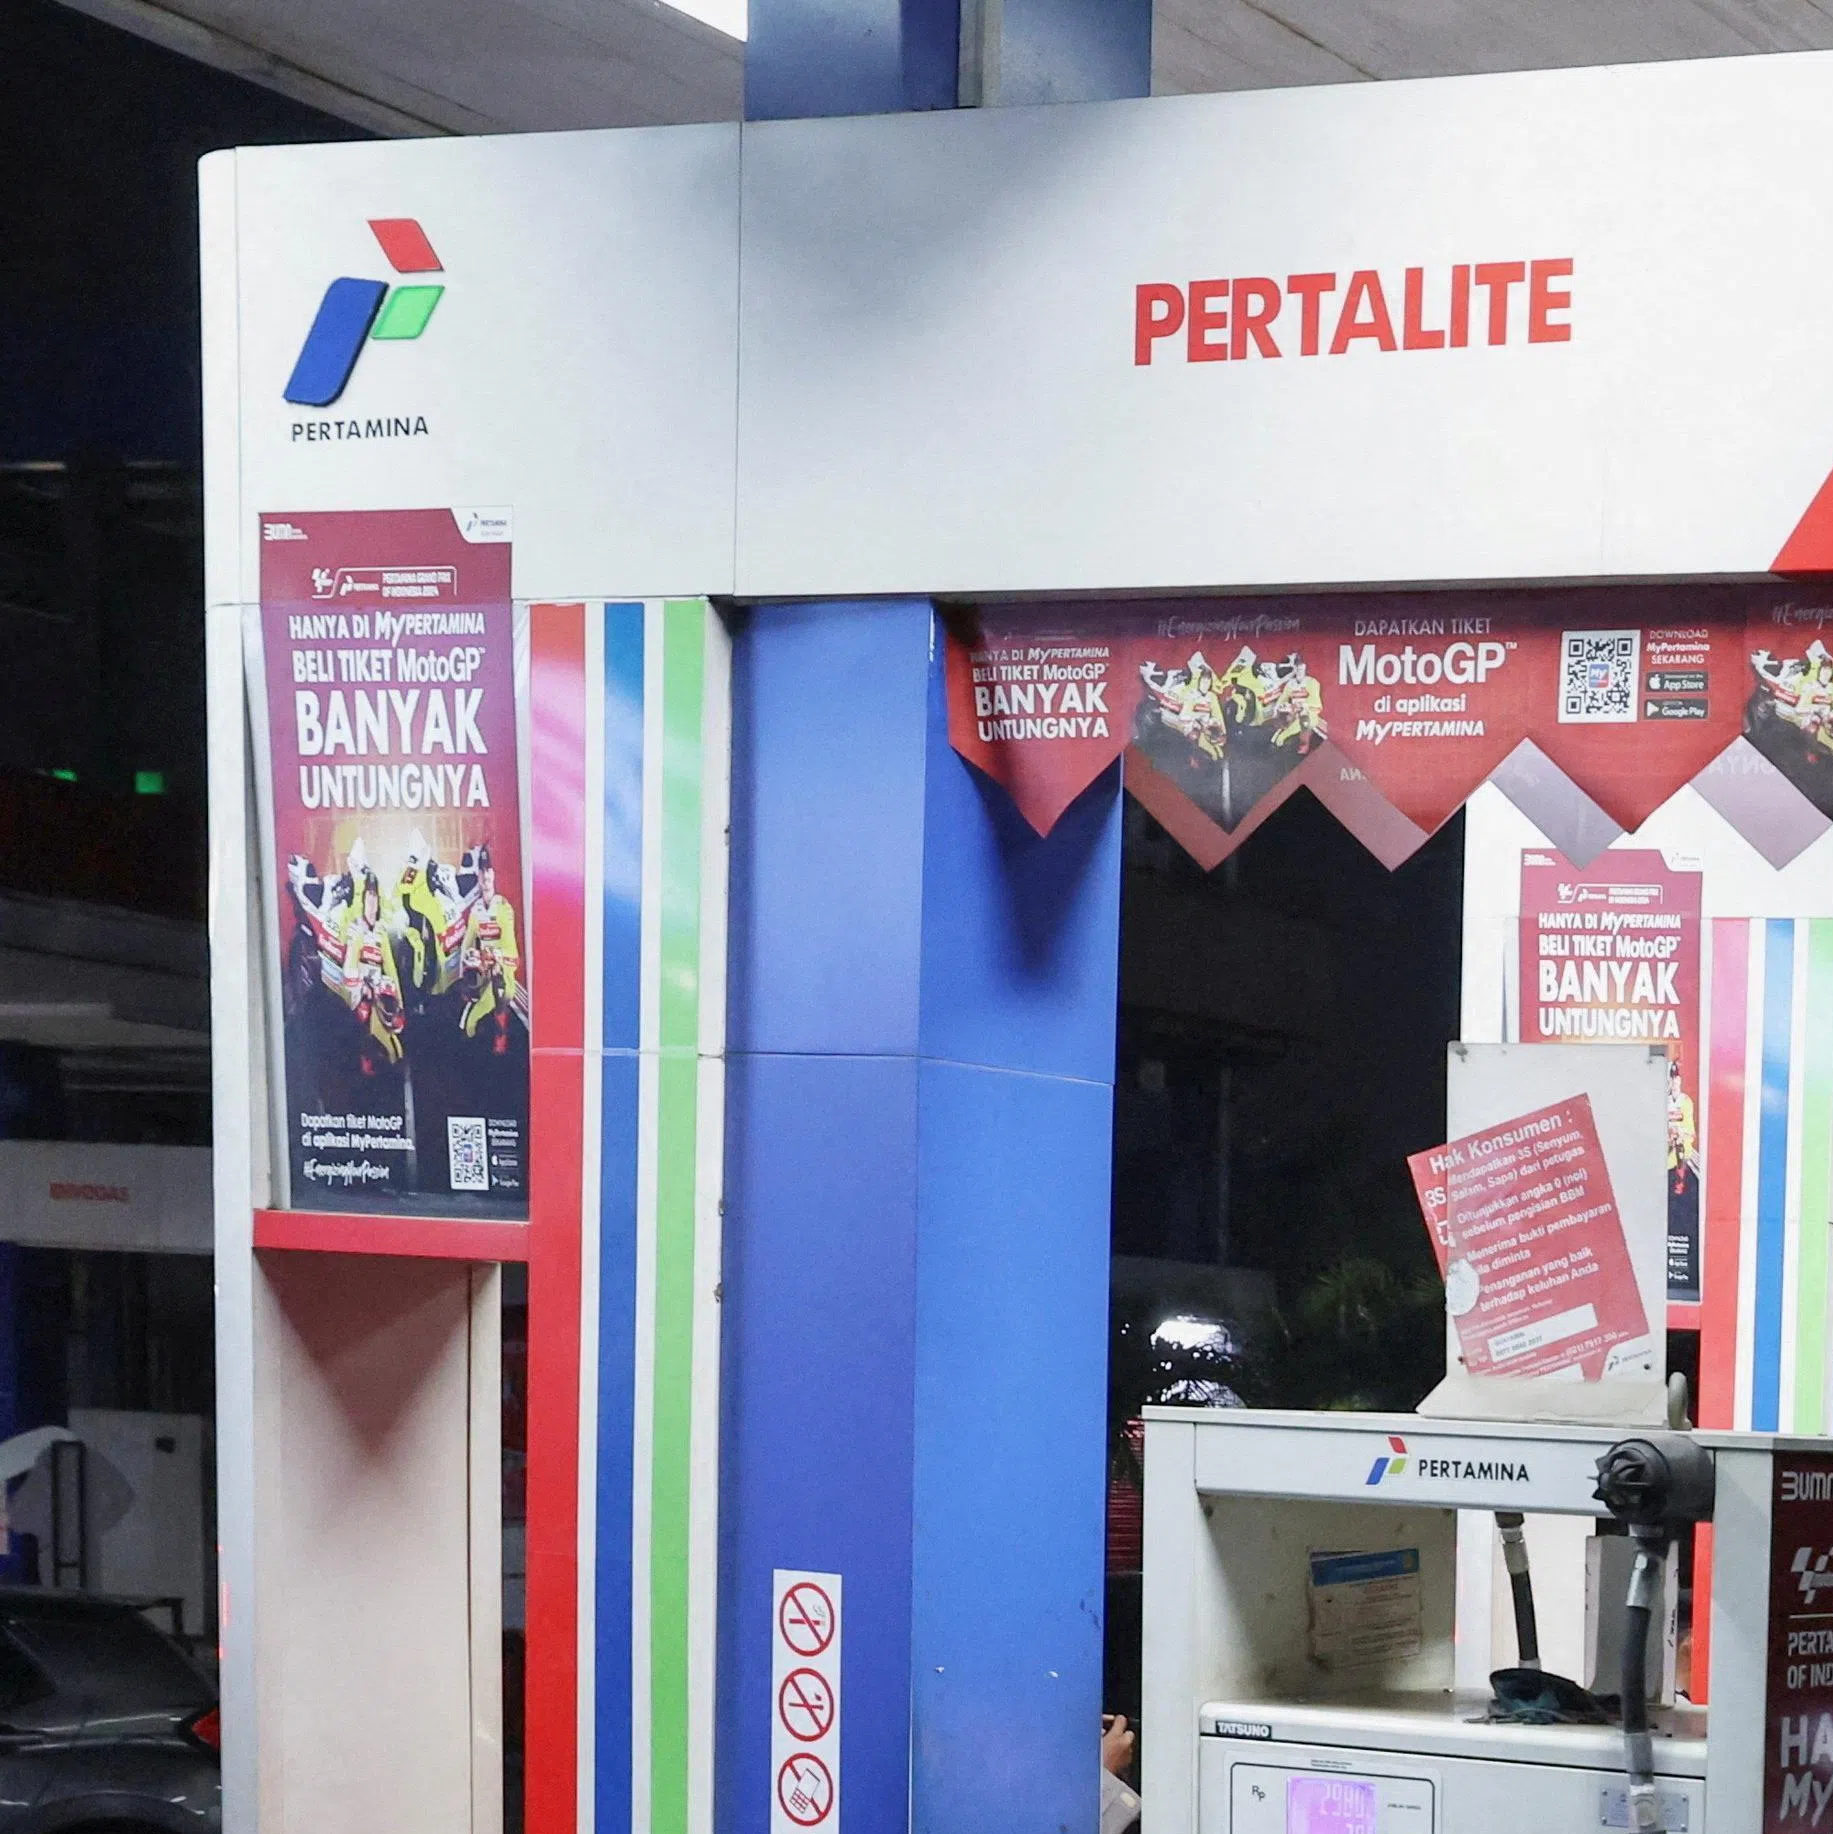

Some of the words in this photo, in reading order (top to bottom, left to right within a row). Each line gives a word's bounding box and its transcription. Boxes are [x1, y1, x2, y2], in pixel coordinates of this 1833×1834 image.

[1134, 257, 1575, 367] PERTALITE
[291, 416, 430, 444] PERTAMINA
[289, 615, 350, 640] HANYA
[353, 614, 370, 638] DI
[374, 611, 485, 648] MyPERTAMINA
[1354, 618, 1446, 637] DAPATKAN
[1450, 617, 1493, 636] TIKET
[1649, 629, 1709, 640] DOWNLOAD
[1011, 648, 1024, 661] DI
[1027, 646, 1111, 663] MyPERTAMINA
[1647, 641, 1711, 655] MyPertamina
[1651, 653, 1705, 665] SEKARANG
[292, 650, 334, 683] BELI
[337, 649, 393, 682] TIKET
[972, 667, 999, 683] BELI
[1000, 664, 1040, 681] TIKET
[1663, 679, 1682, 692] App
[1683, 678, 1704, 691] Store
[974, 682, 1110, 717] BANYAK
[1374, 695, 1391, 713] di
[1395, 693, 1467, 717] aplikasi
[1661, 705, 1687, 718] Google
[295, 688, 489, 756] BANYAK
[978, 716, 1110, 742] UNTUNGNYA
[1356, 719, 1486, 745] MyPERTAMINA
[300, 763, 491, 810] UNTUNGNYA
[1538, 912, 1582, 929] HANYA
[1584, 913, 1598, 929] DI
[1538, 934, 1570, 956] BELI
[1572, 934, 1613, 957] TIKET
[1538, 959, 1681, 1005] BANYAK
[1539, 1008, 1680, 1039] UNTUNGNYA
[1429, 1152, 1465, 1175] Hak
[1467, 1114, 1563, 1160] Konsumen
[1518, 1146, 1531, 1161] 3S
[1520, 1160, 1542, 1177] dari
[1542, 1146, 1585, 1170] petugas
[1424, 1186, 1447, 1208] 3S
[1521, 1181, 1554, 1201] angka
[1462, 1217, 1506, 1240] sebelum
[1547, 1202, 1612, 1234] pembayaran
[1491, 1248, 1531, 1269] diminta
[1542, 1257, 1569, 1278] yang
[1569, 1247, 1593, 1262] baik
[1480, 1289, 1526, 1312] terhadap
[1528, 1274, 1569, 1295] keluhan
[1570, 1261, 1599, 1280] Anda
[1417, 1458, 1530, 1484] PERTAMINA
[1787, 1665, 1807, 1690] OF
[1216, 1722, 1270, 1737] TATSUNO
[1251, 1785, 1266, 1802] Rp
